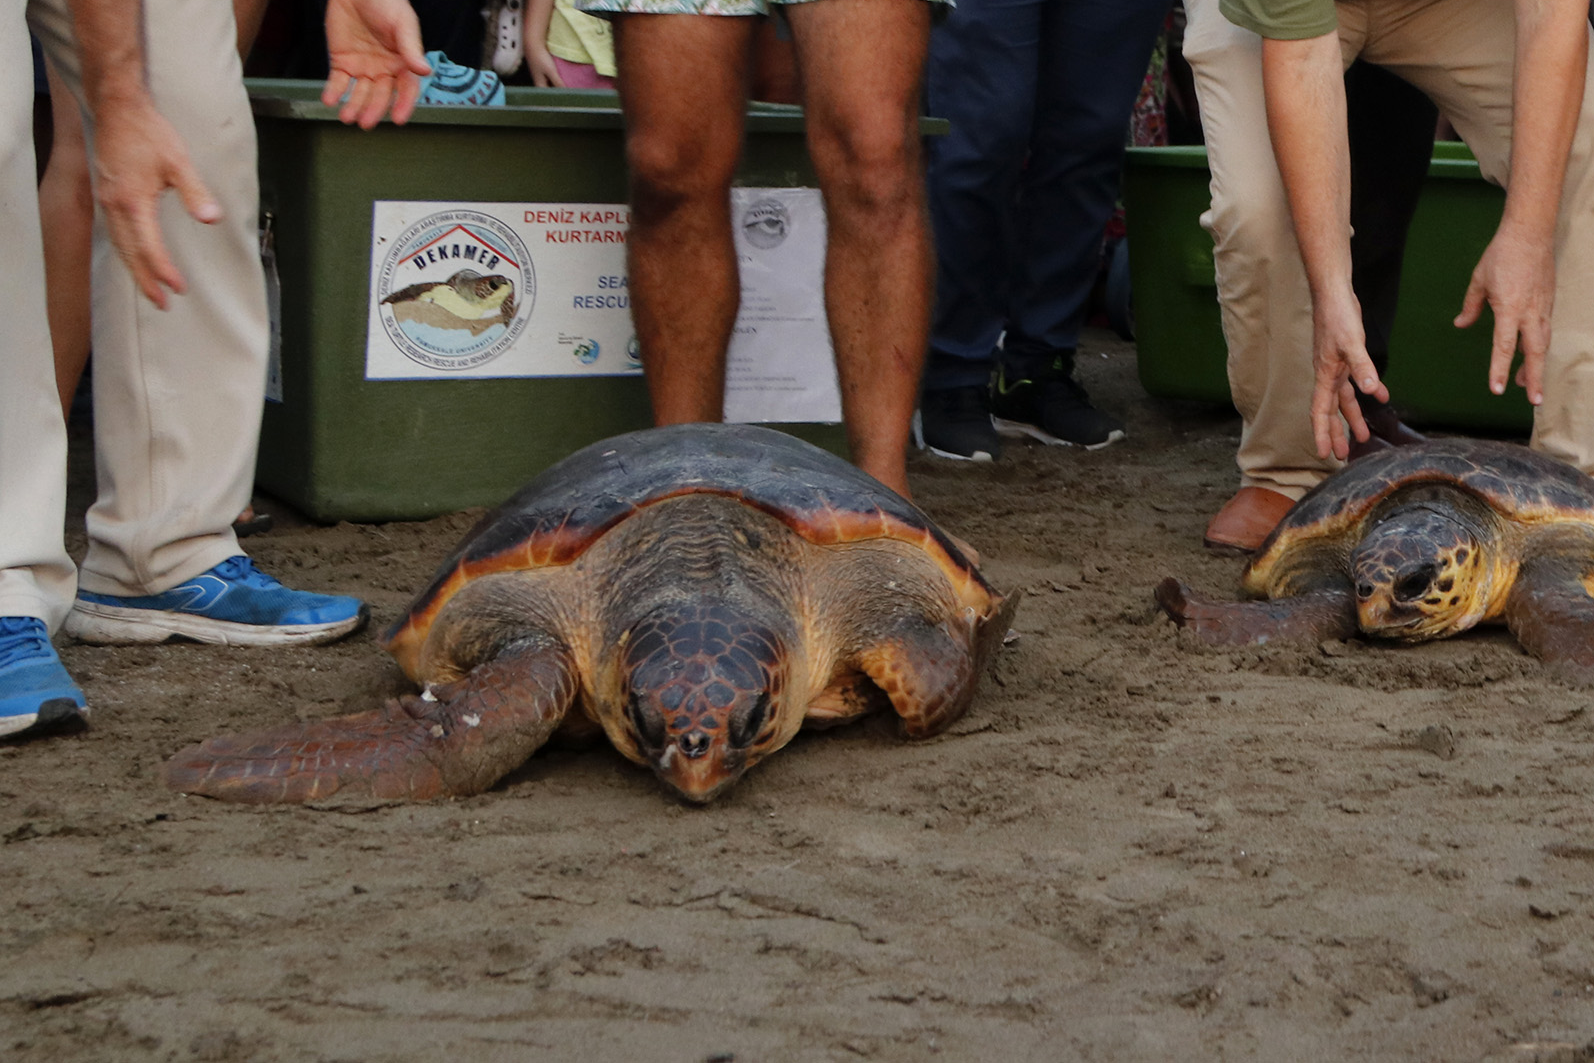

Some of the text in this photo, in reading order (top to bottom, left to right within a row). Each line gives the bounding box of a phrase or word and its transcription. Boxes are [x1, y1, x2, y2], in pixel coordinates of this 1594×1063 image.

[524, 208, 575, 224] DENİZ
[546, 229, 627, 244] KURTARM
[413, 243, 501, 271] DEKAMER
[598, 275, 628, 289] SEA
